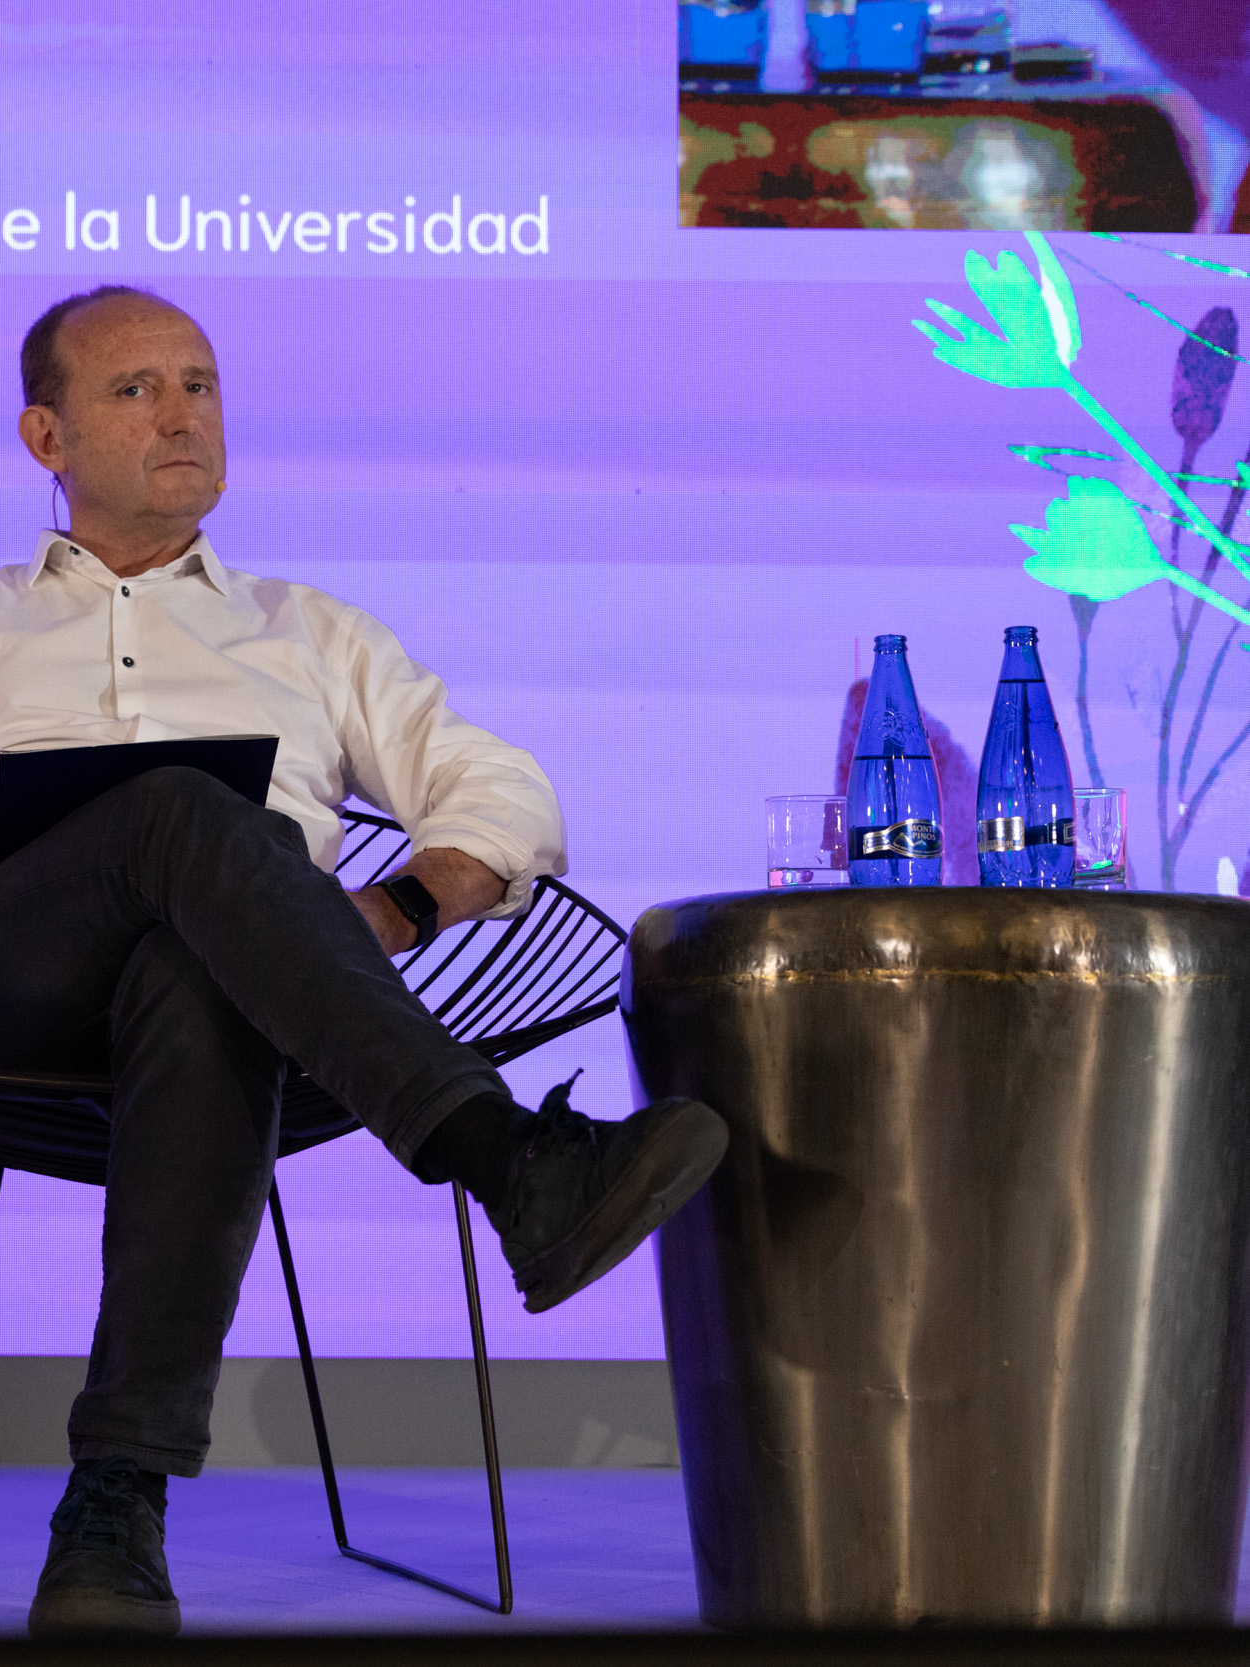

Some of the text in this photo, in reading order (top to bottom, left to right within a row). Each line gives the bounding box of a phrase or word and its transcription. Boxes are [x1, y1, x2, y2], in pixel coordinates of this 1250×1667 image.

[65, 190, 120, 252] la
[145, 192, 550, 256] Universidad
[912, 832, 937, 841] PINOS
